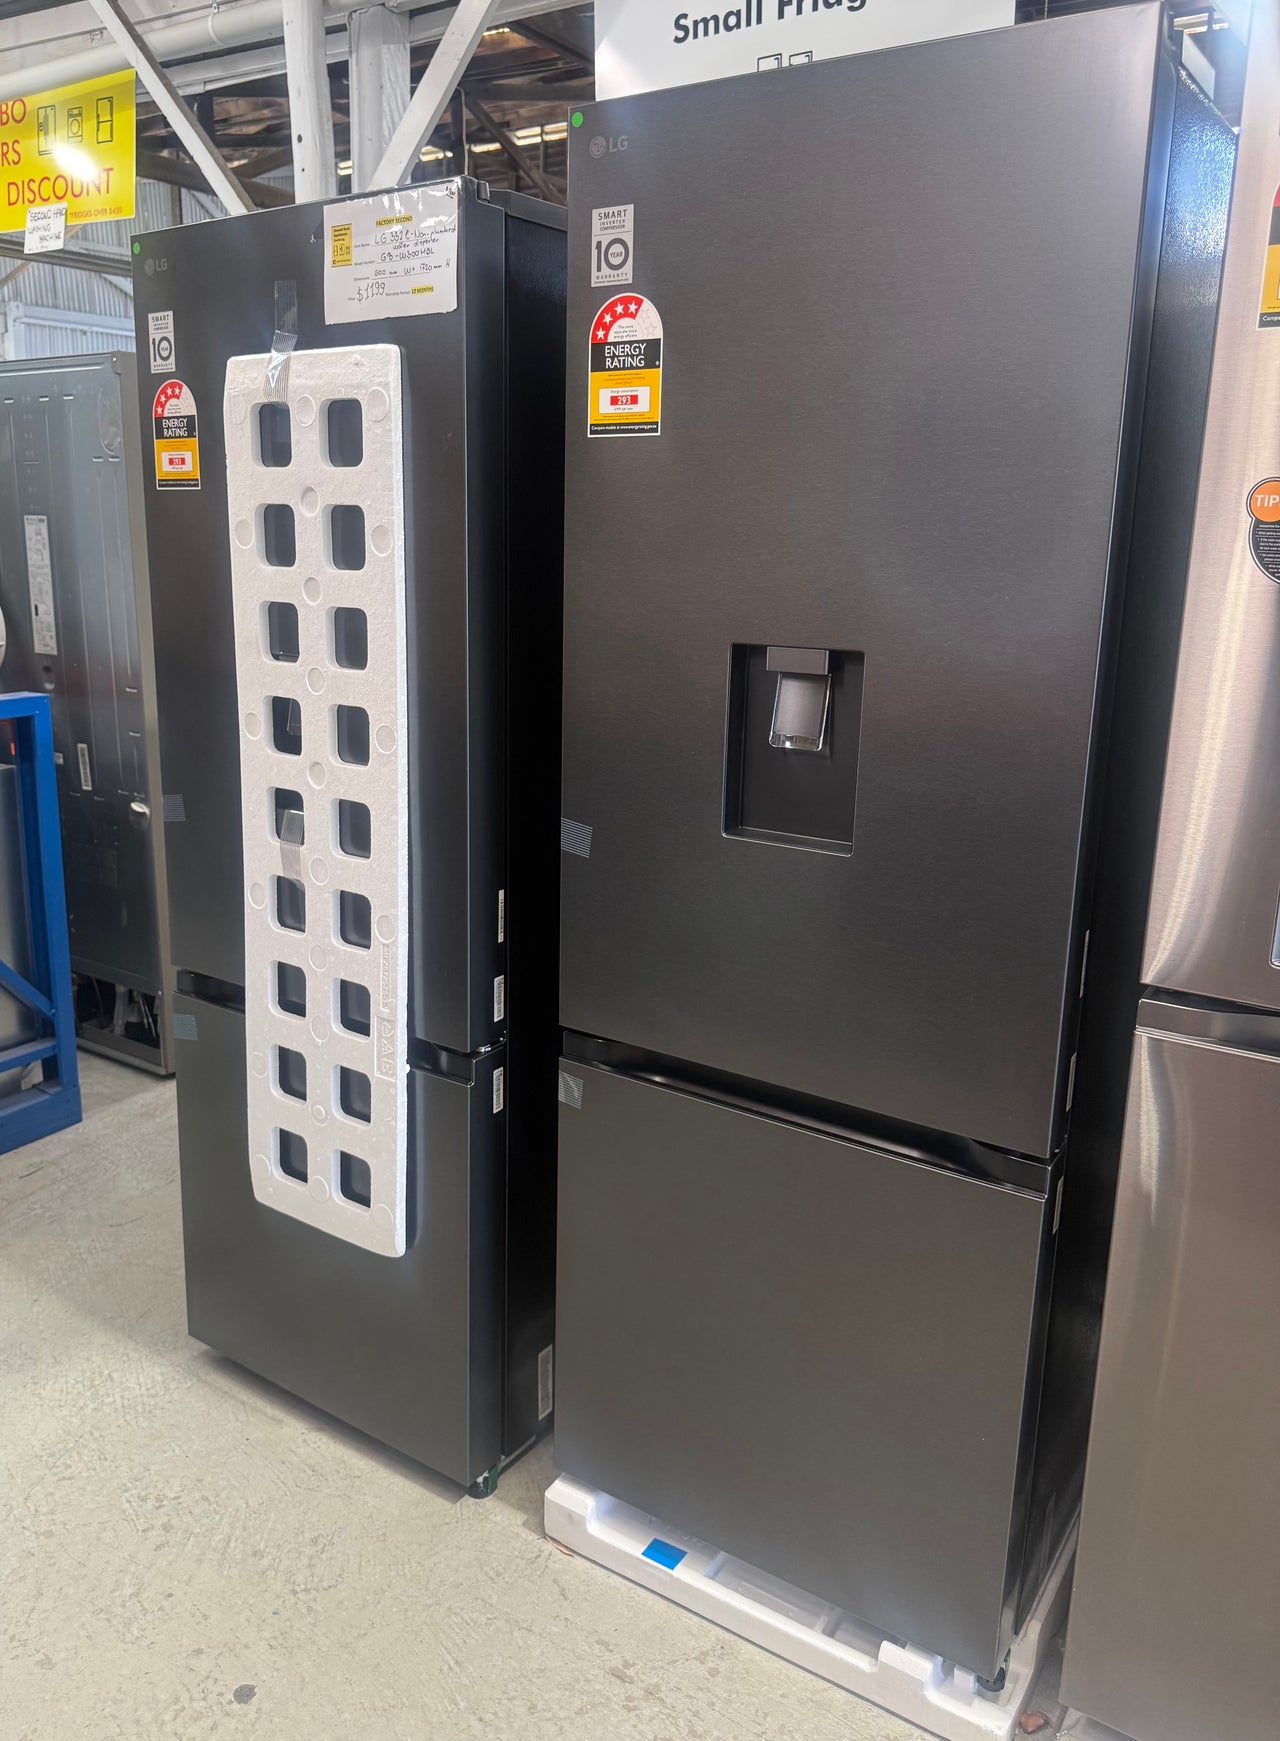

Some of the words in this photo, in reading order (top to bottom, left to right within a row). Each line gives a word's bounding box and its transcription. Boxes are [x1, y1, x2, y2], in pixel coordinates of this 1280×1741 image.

[673, 0, 763, 44] Small
[609, 135, 628, 153] LG
[1, 139, 21, 167] RS
[7, 167, 114, 207] DISCOUNT
[395, 215, 413, 224] SECOND
[598, 209, 628, 221] SMART
[599, 218, 626, 227] INVERTER
[375, 232, 387, 244] LG
[595, 237, 630, 273] 10
[610, 251, 623, 259] YEAR
[155, 258, 168, 272] LG
[596, 272, 628, 280] WARRANTY
[356, 281, 386, 304] $1199
[151, 314, 170, 323] SMART
[152, 336, 172, 362] 10
[604, 343, 646, 357] ENERGY
[605, 356, 645, 369] RATING
[617, 395, 631, 405] 293
[162, 417, 188, 428] ENERGY
[163, 428, 188, 437] RATING
[1255, 494, 1280, 508] TIP
